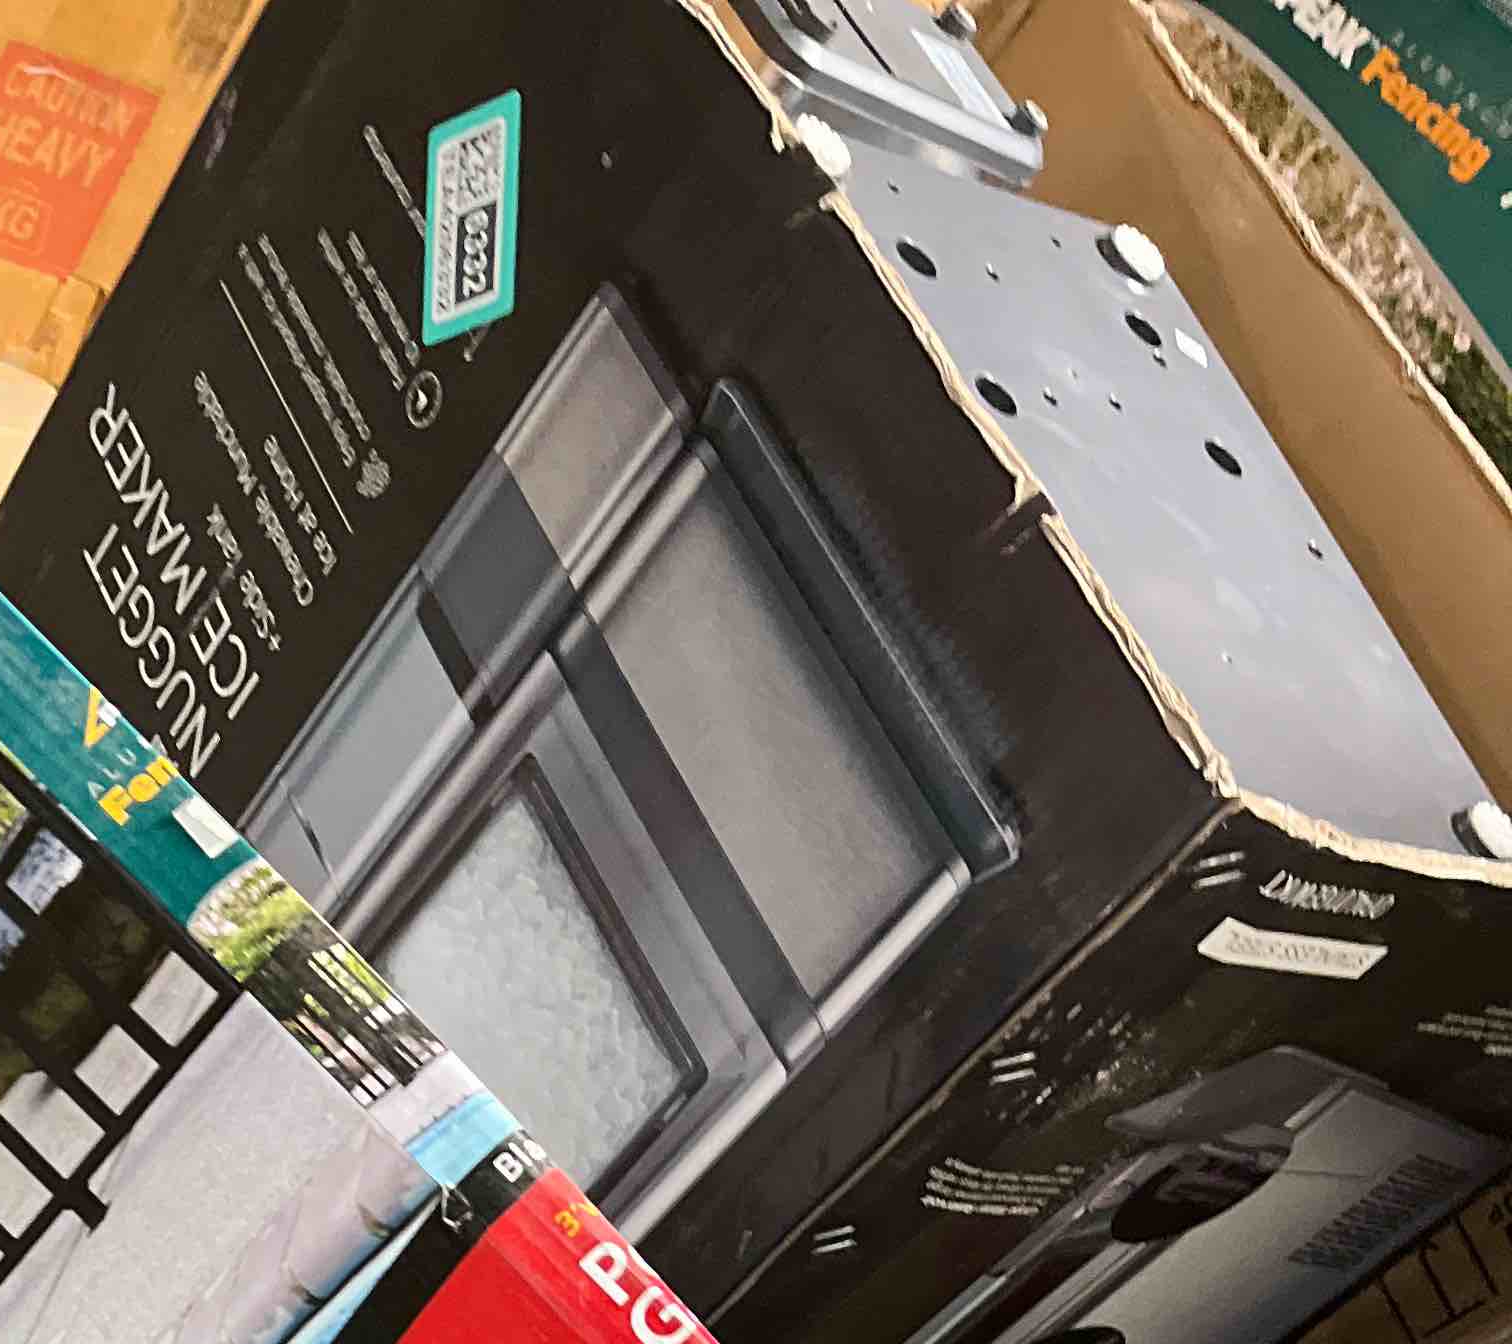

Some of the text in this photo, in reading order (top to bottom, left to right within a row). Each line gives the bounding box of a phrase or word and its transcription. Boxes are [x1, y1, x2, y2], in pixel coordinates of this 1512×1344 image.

[3, 61, 141, 138] CAUTION
[1361, 48, 1492, 185] Fencing
[89, 384, 258, 719] ICE MAKER
[84, 525, 219, 776] NUGGET
